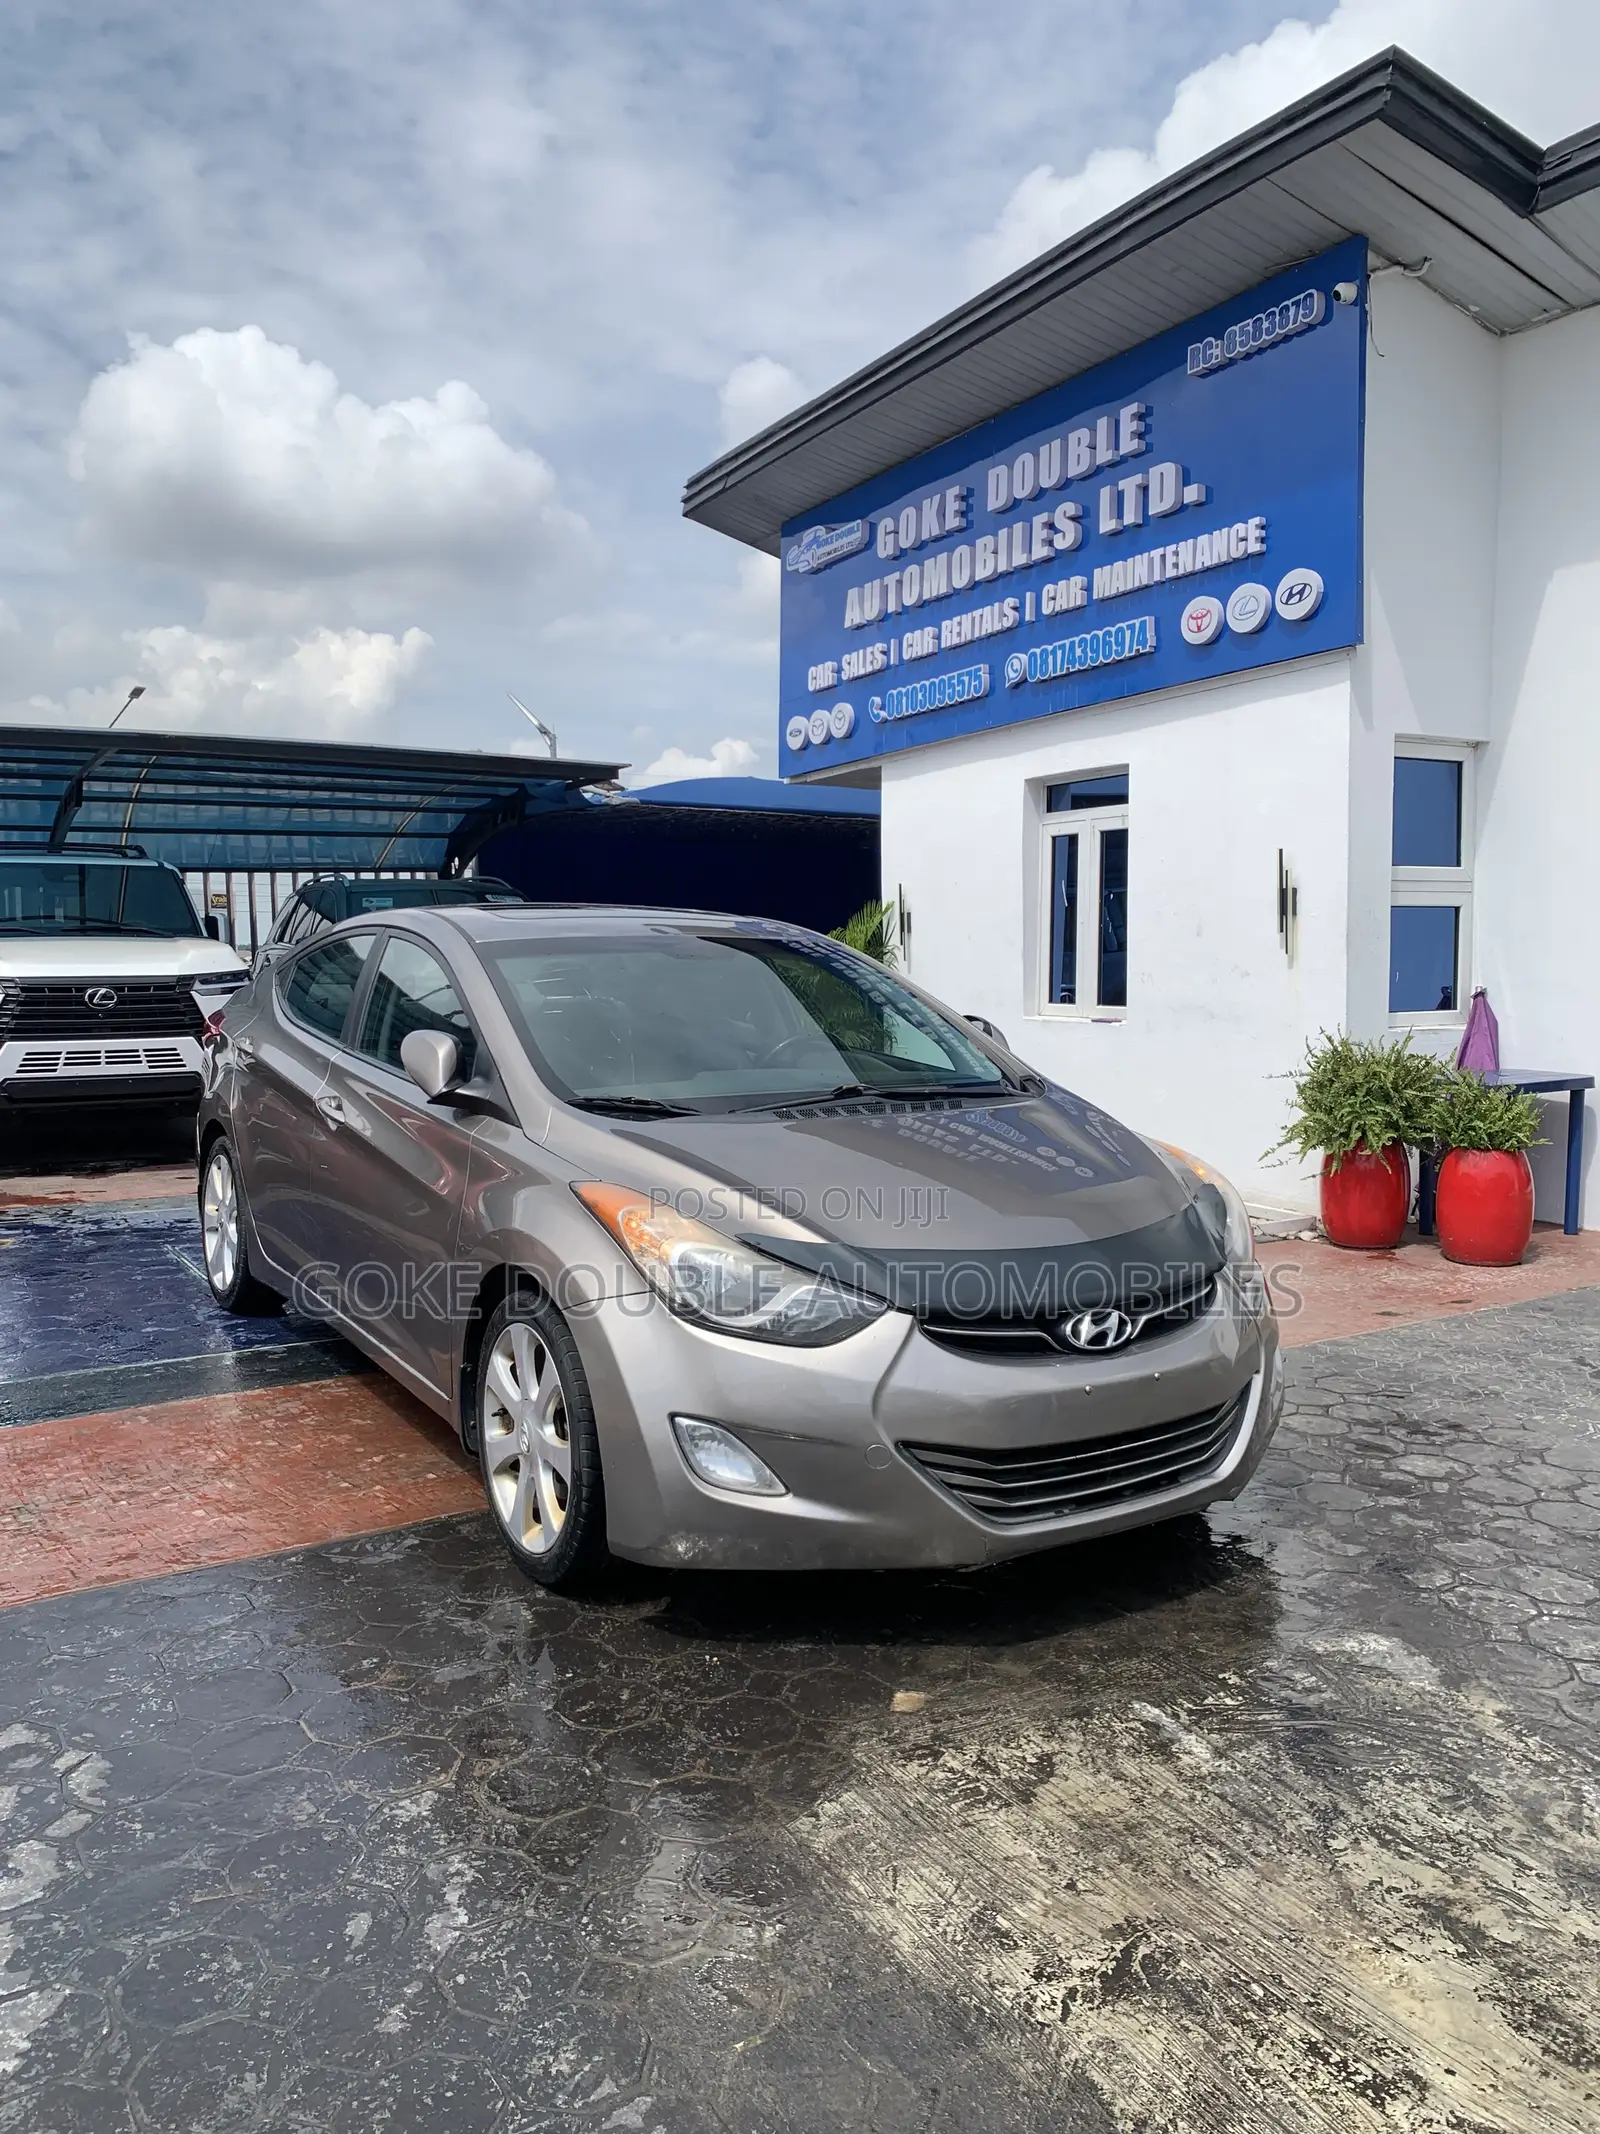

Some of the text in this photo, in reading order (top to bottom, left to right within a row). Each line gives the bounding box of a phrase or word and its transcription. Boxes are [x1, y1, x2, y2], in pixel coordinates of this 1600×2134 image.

[1188, 289, 1320, 375] RC: 8583879
[844, 462, 1206, 630] AUTOMOBILES LTD.
[877, 402, 1147, 560] GOKE DOUBLE
[808, 661, 838, 692] CAR
[842, 642, 887, 681] SALES
[903, 626, 939, 661] CAR
[941, 597, 1020, 649] RENTALS
[1042, 575, 1088, 616] CAR
[1093, 516, 1267, 600] MAINTENANCE
[885, 617, 1150, 720] 08103095575 08174396974
